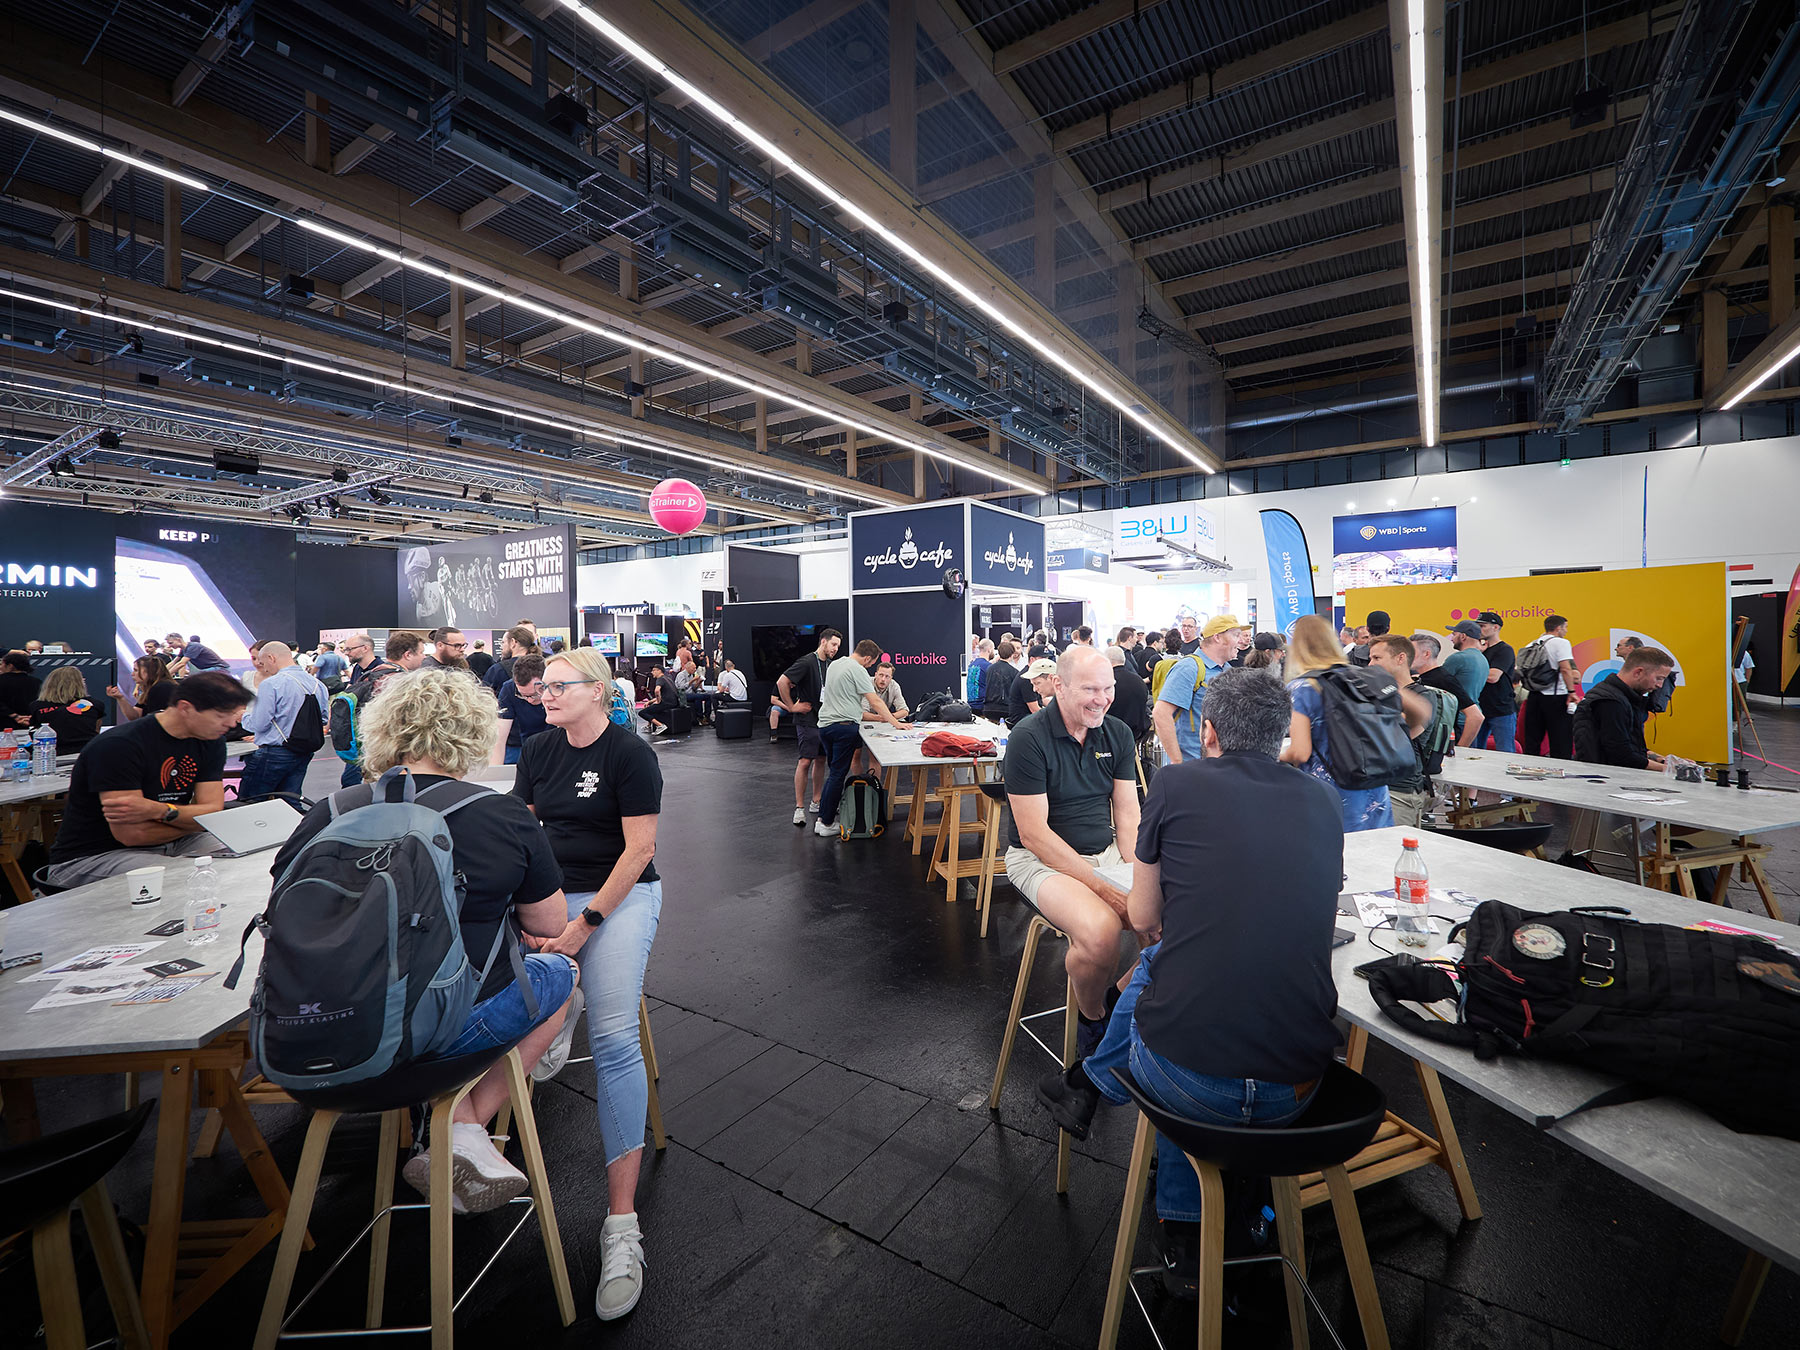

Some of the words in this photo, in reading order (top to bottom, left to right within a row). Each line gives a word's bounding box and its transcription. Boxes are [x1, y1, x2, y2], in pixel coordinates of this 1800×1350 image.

[159, 529, 197, 542] KEEP
[1379, 527, 1398, 535] WBD
[1402, 526, 1427, 534] Sports
[505, 536, 563, 560] GREATNESS
[864, 546, 898, 573] cycle
[920, 541, 953, 568] cafe
[984, 546, 1006, 569] cycle
[0, 563, 97, 588] MIN
[498, 559, 535, 580] STARTS
[536, 555, 563, 575] WITH
[523, 575, 564, 596] GARMIN
[895, 652, 947, 665] Eurobike
[40, 706, 59, 714] TEA
